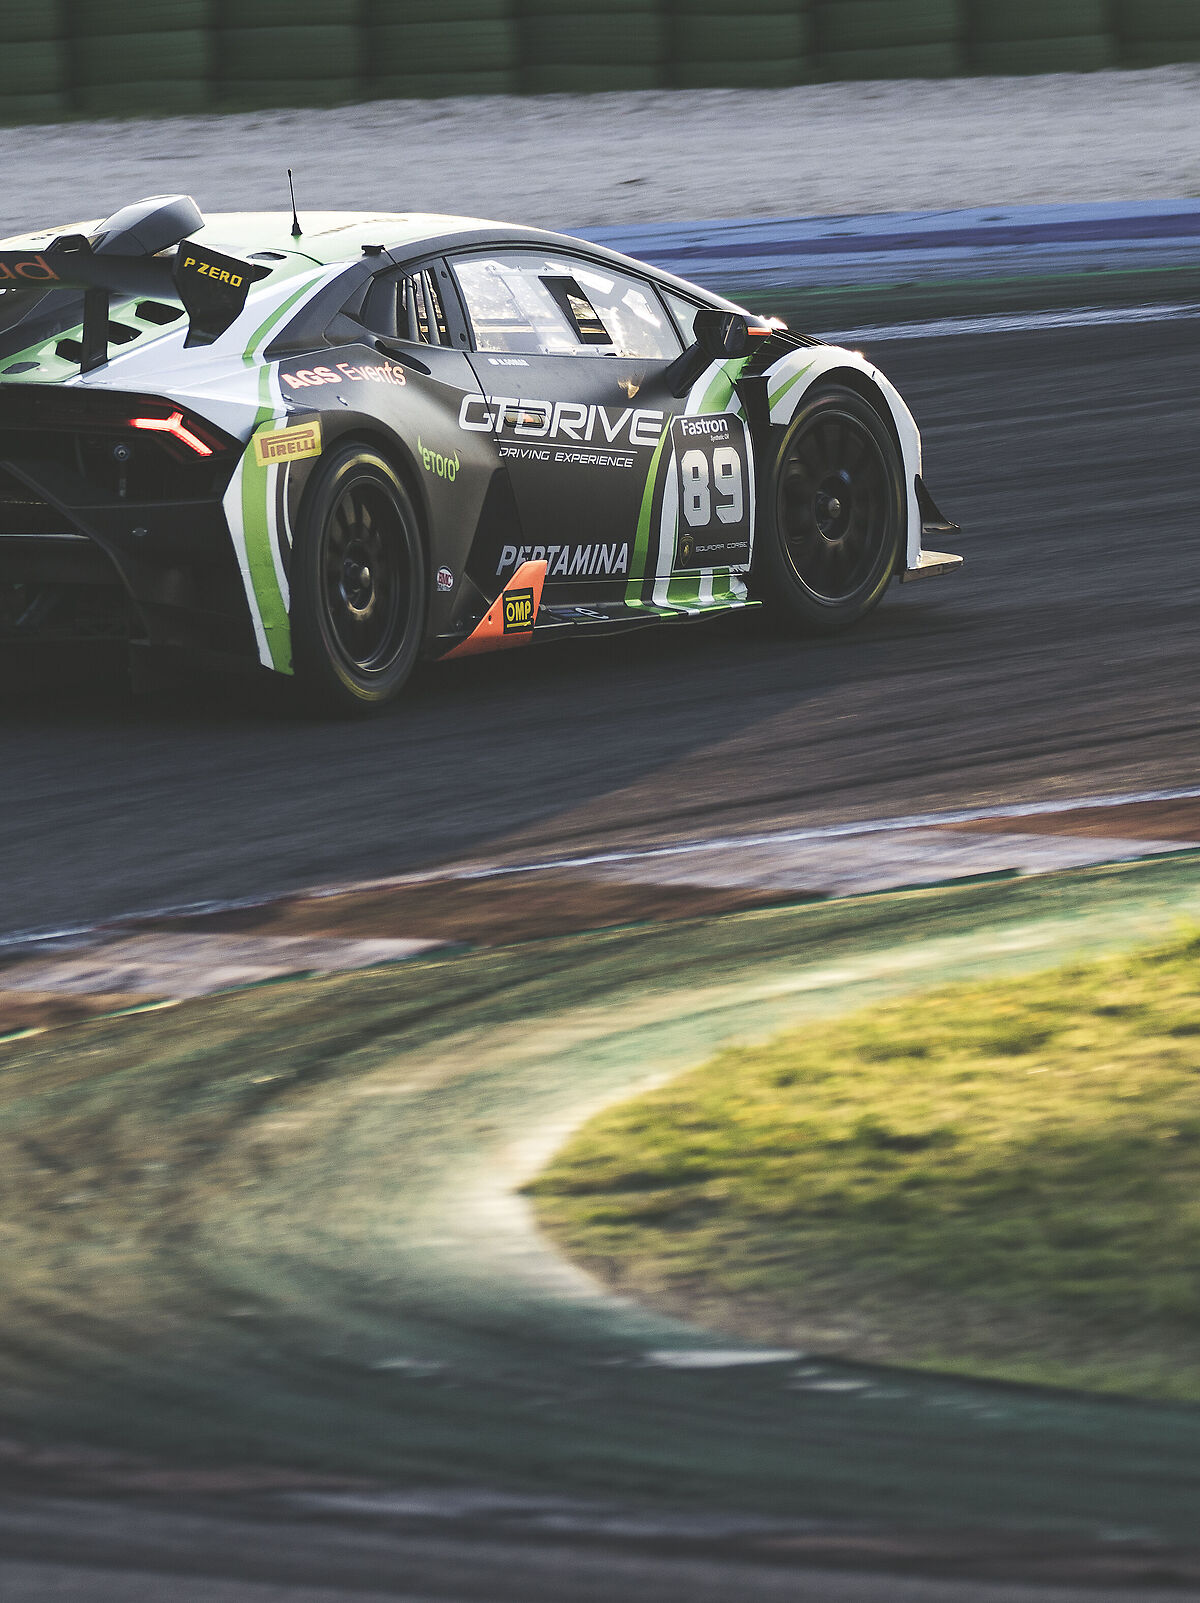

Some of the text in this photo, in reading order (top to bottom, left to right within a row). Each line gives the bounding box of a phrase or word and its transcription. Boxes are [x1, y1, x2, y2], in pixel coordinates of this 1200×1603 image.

[184, 257, 243, 288] P ZERO
[281, 361, 407, 390] AGS Events
[680, 418, 729, 436] Fastron
[260, 429, 316, 459] PIRELLI
[498, 447, 634, 468] DRIVING EXPERIENCE
[681, 446, 744, 527] 89
[506, 600, 532, 622] OMP
